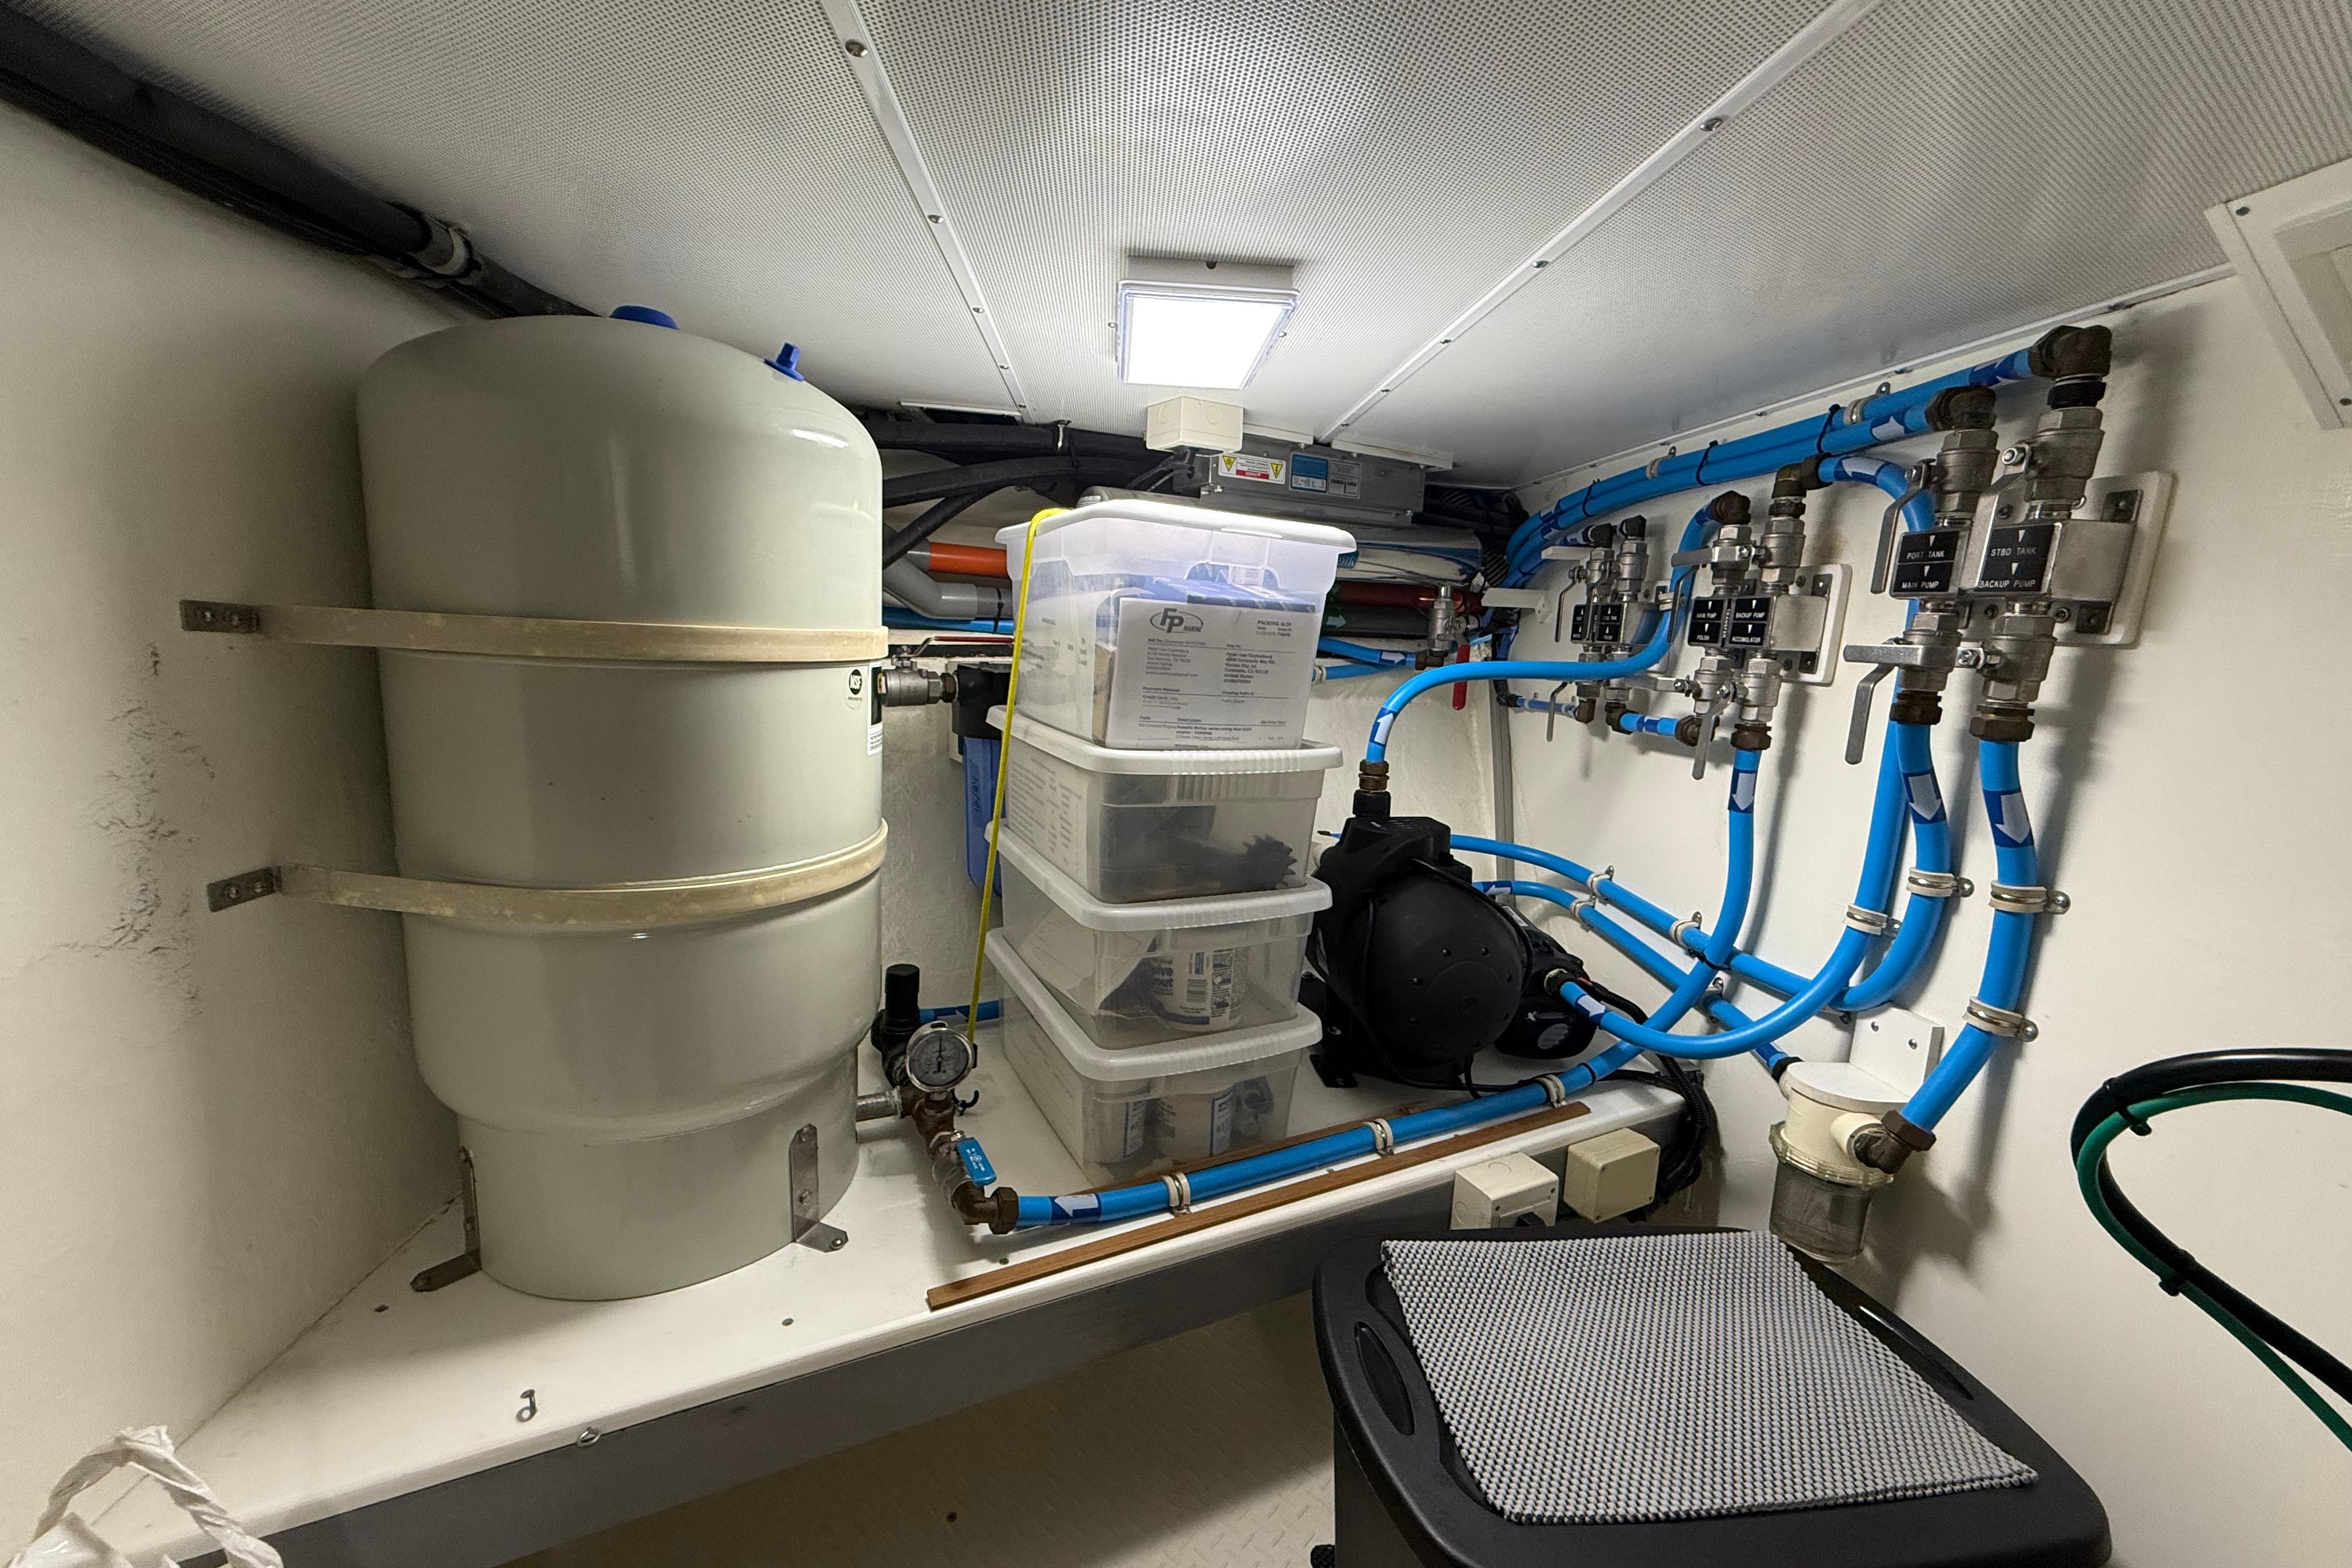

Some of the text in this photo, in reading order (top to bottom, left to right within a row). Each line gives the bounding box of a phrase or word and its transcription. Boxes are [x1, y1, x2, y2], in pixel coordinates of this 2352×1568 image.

[1906, 550, 1945, 559] PORT TANK
[1991, 547, 2037, 557] STBD TANK
[1902, 580, 1939, 589] MAIN PUMP
[1978, 579, 2036, 588] BACKUP PUMP
[849, 674, 862, 690] NSF
